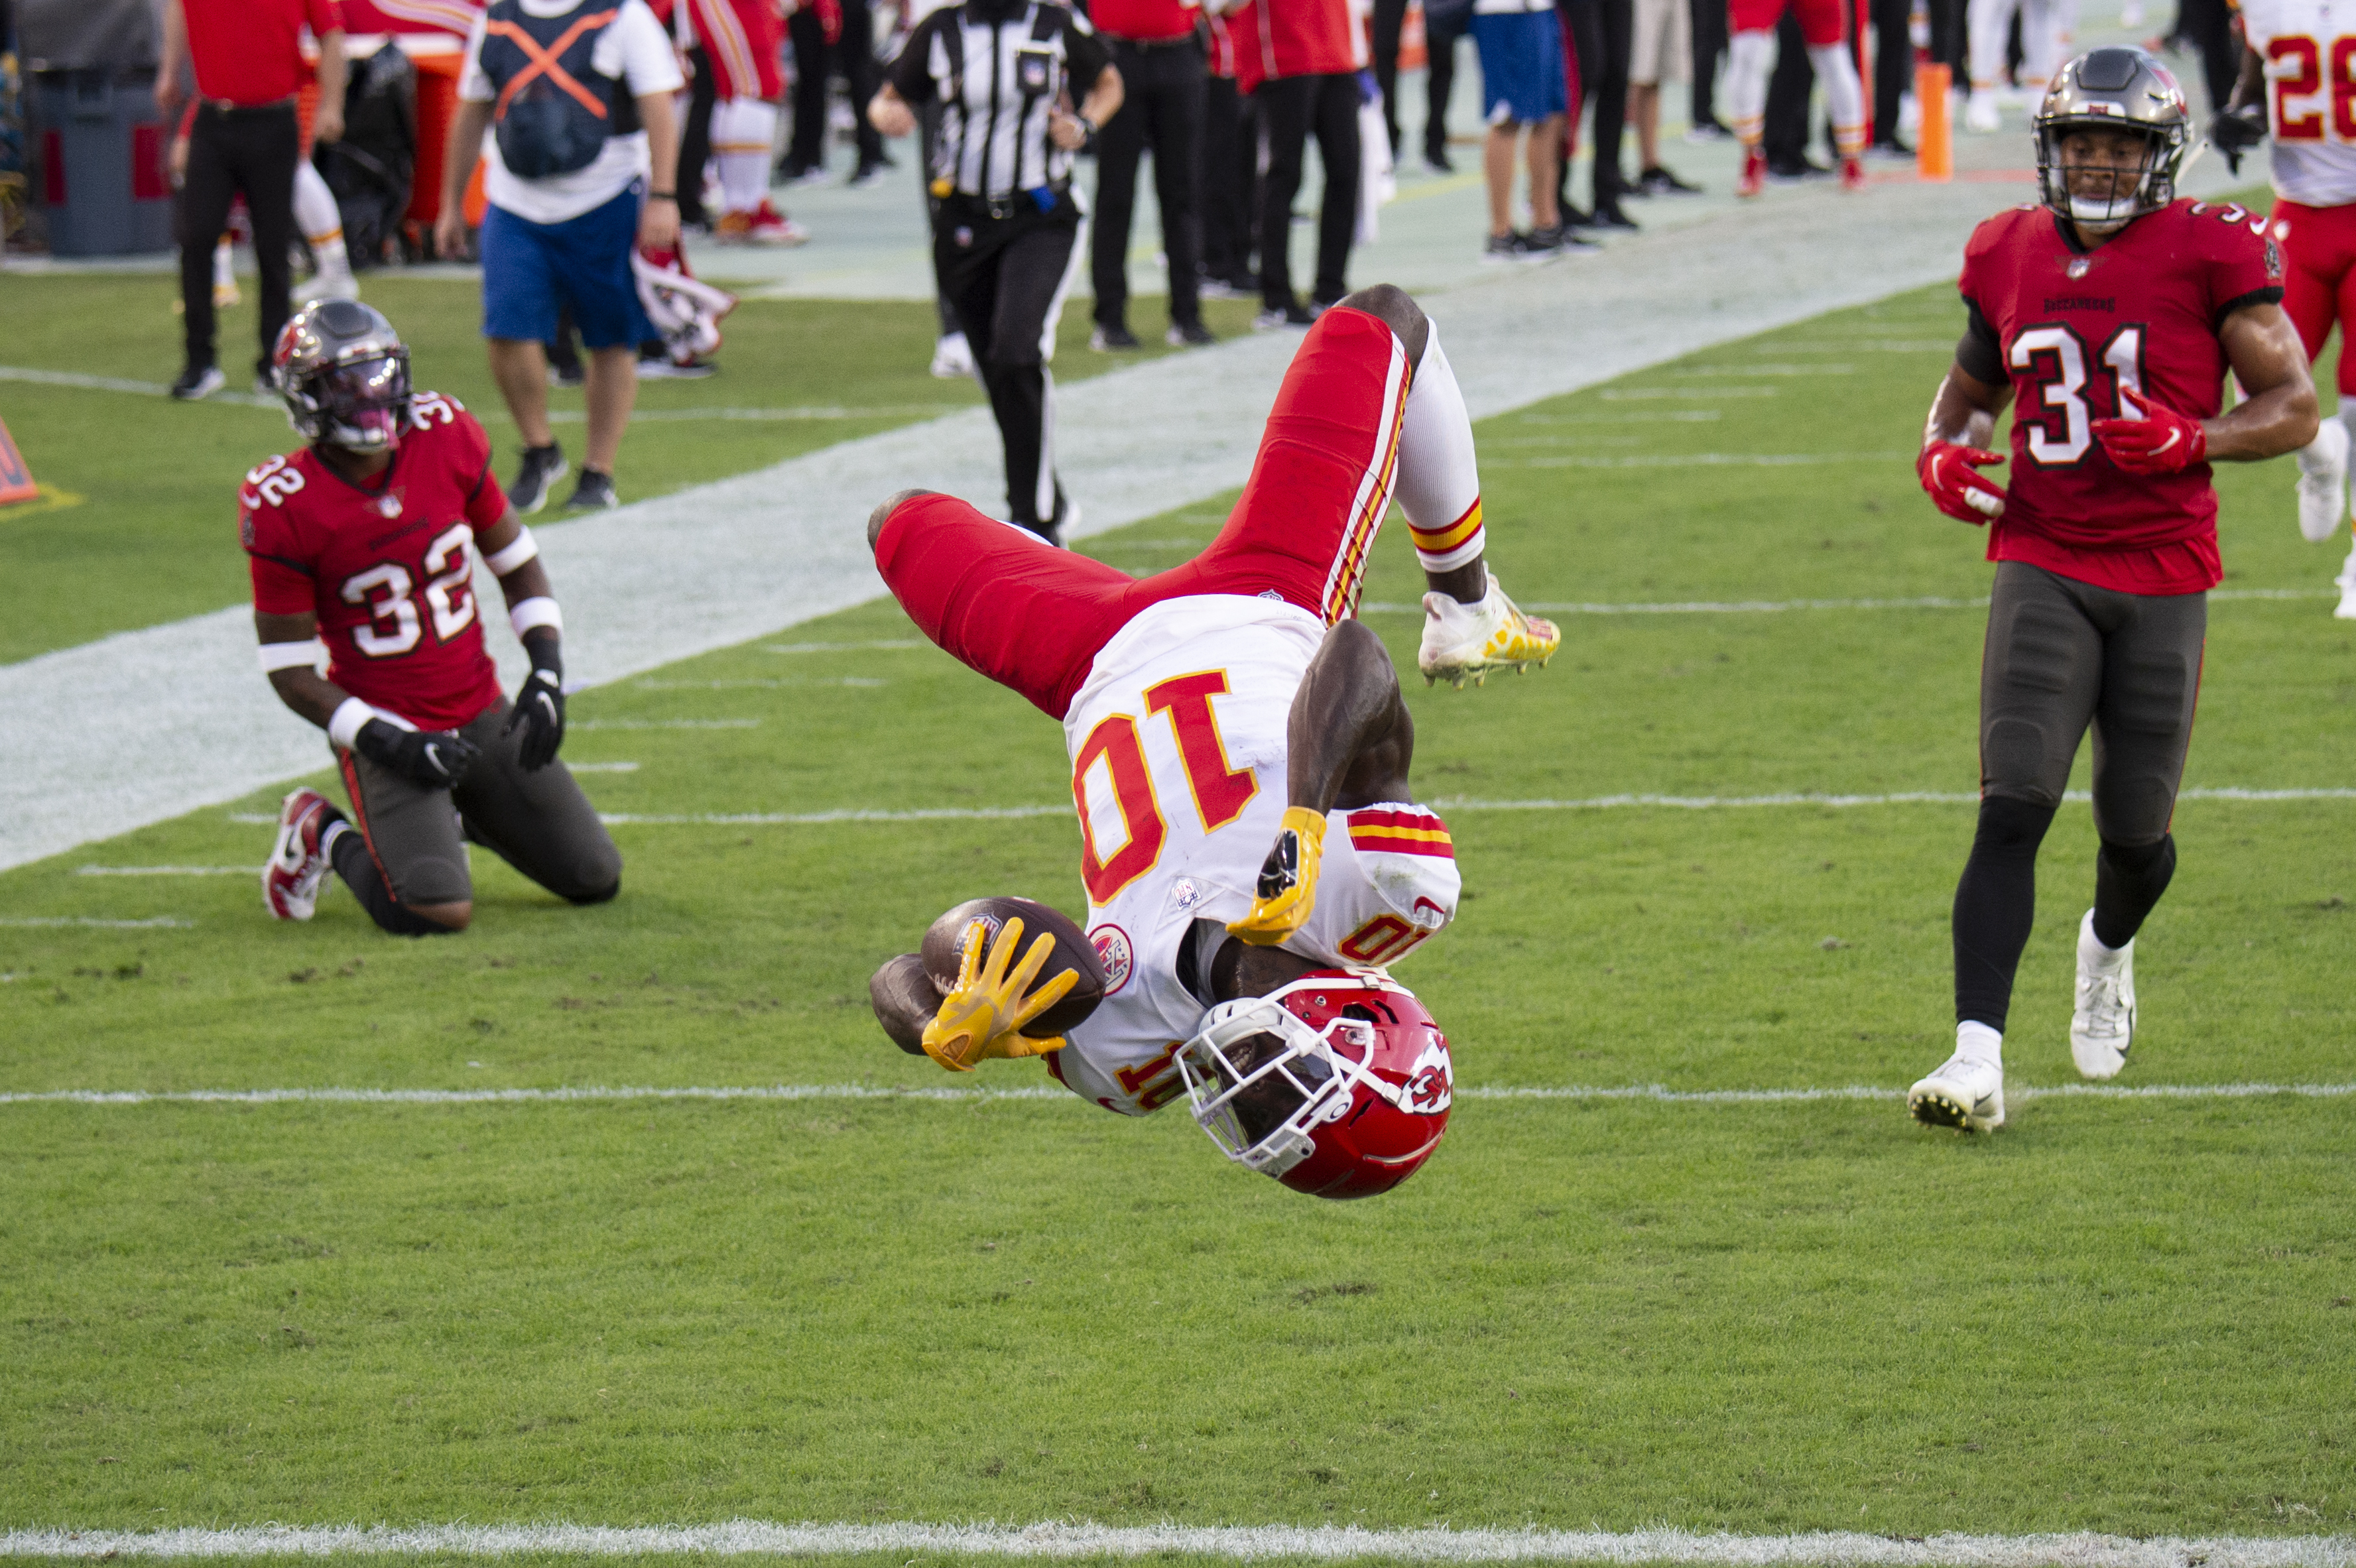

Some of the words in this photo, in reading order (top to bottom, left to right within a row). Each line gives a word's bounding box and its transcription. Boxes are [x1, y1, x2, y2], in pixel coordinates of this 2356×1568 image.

[2009, 321, 2150, 472] 31
[245, 453, 306, 508] 32
[340, 521, 476, 662] 32
[1073, 668, 1261, 908] 10
[1337, 913, 1437, 967] 10
